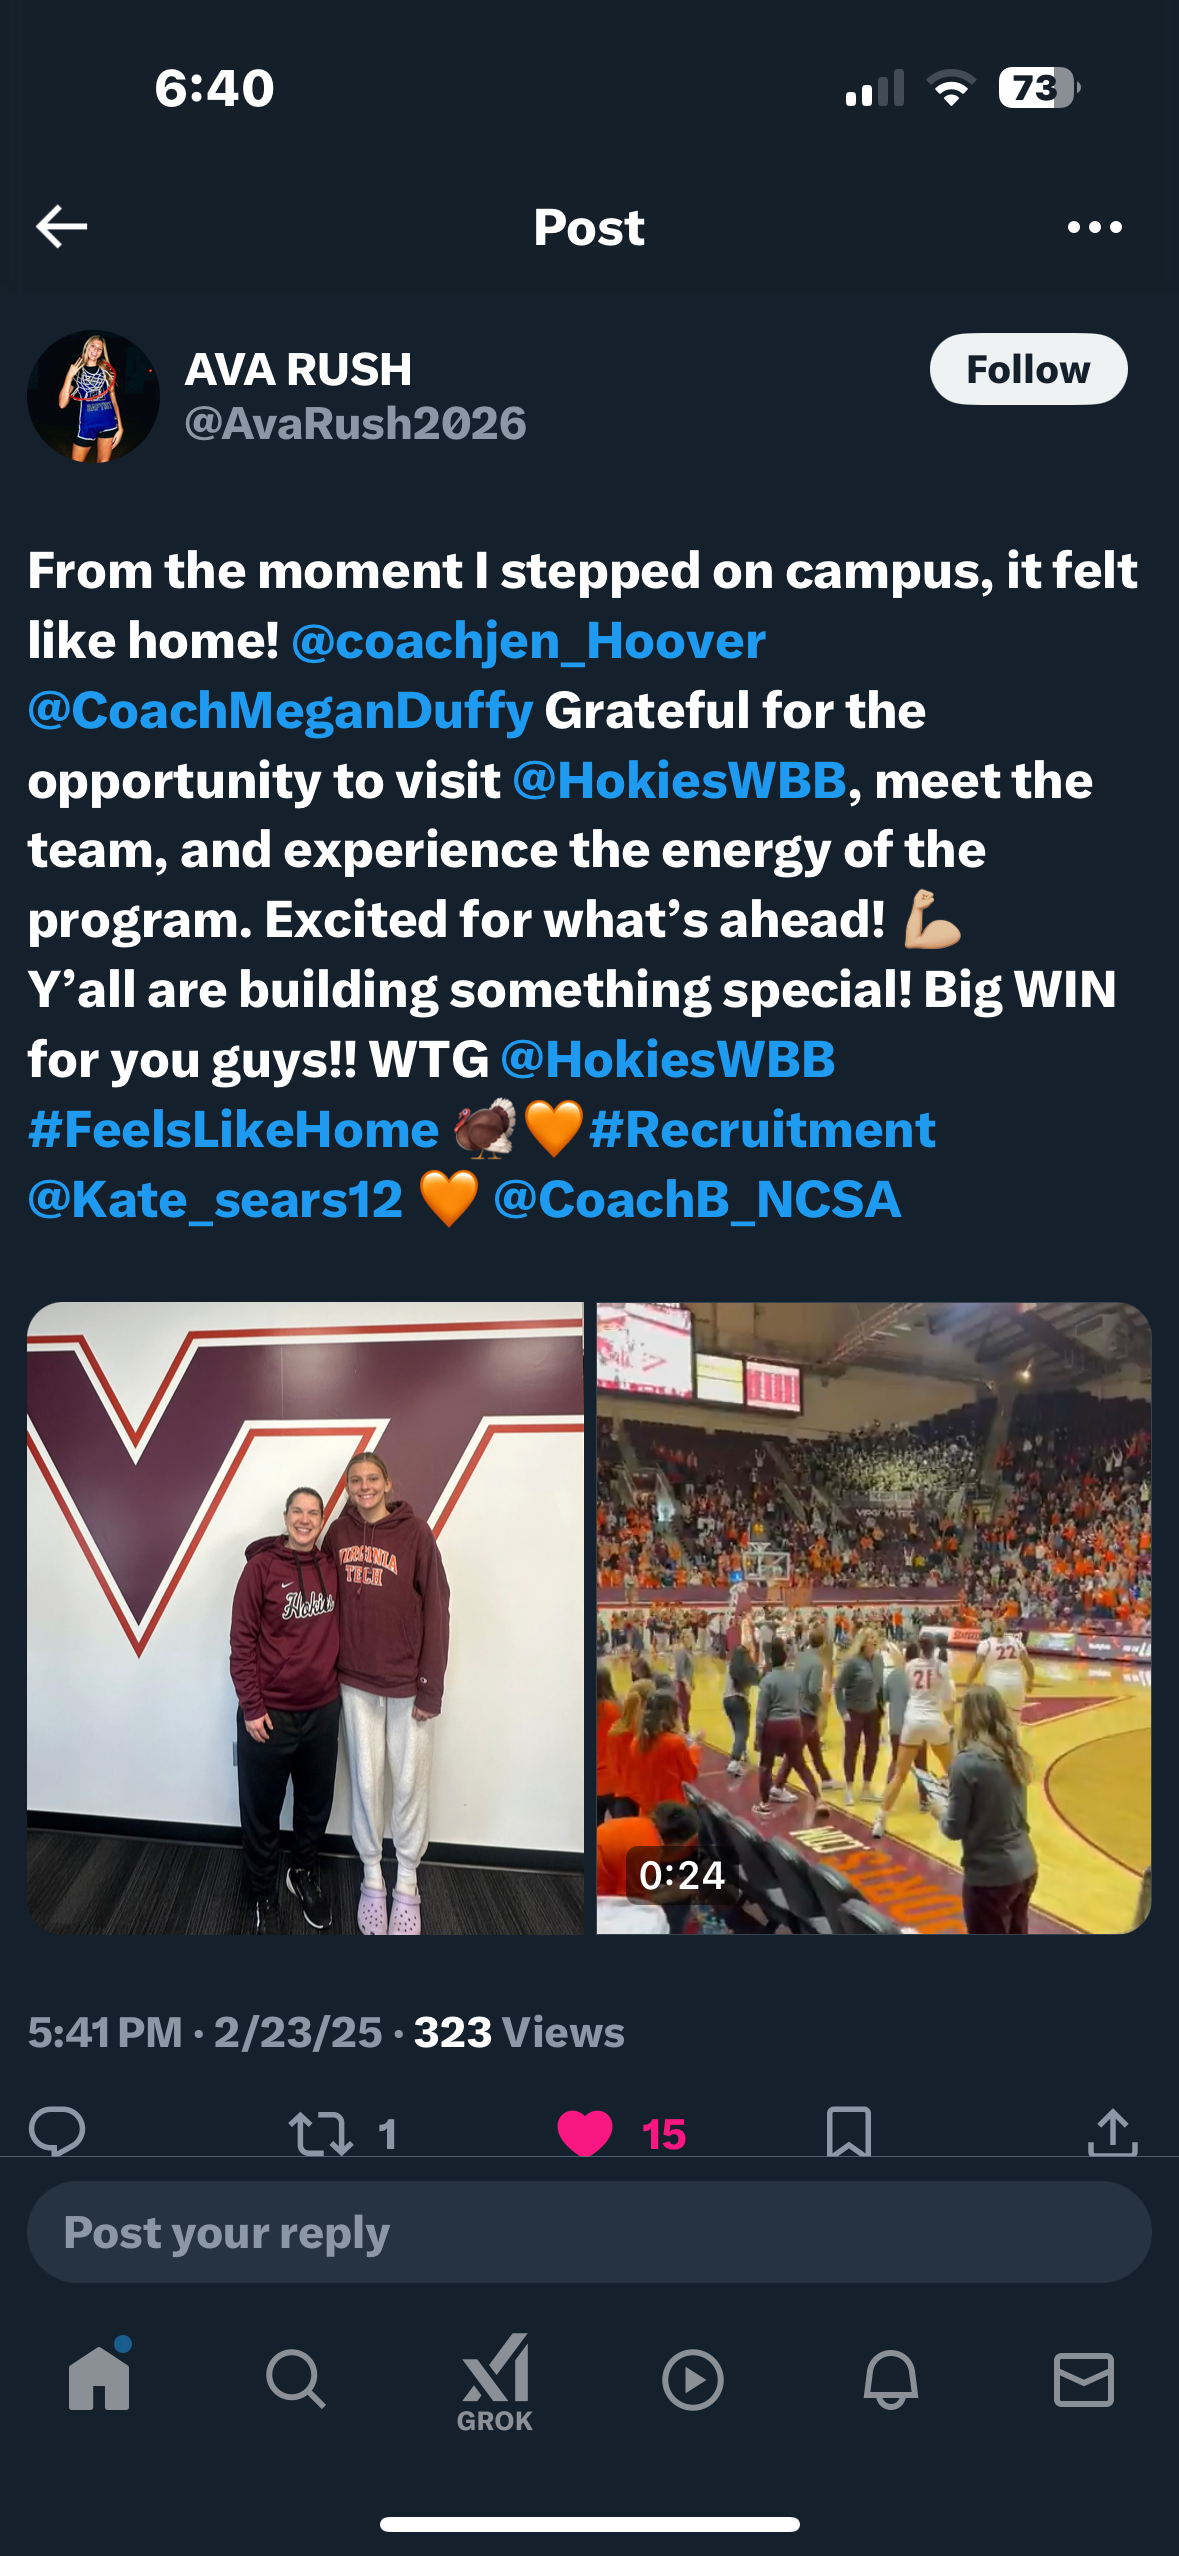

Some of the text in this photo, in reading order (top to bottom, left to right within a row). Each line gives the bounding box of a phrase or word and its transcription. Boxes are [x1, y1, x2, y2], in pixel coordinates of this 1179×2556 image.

[156, 69, 274, 107] 6:40
[1013, 74, 1058, 101] 73
[536, 209, 644, 246] Post
[184, 352, 410, 386] AVA RUSH
[968, 354, 1091, 384] Follow
[186, 406, 526, 440] @AvaRush2026
[30, 549, 1137, 598] From the moment I stepped on campus, it felt
[30, 619, 766, 669] like home! @coachjen_Hoover
[29, 689, 926, 739] @CoachMeganDuffy Grateful for the
[28, 759, 1093, 809] opportunity to visit @HokiesWBB, meet the
[27, 828, 986, 878] team, and experience the energy of the
[30, 898, 884, 948] program. Excited for what’s ahead!
[27, 968, 1115, 1018] Y’all are building something special! Big WIN
[27, 1038, 834, 1088] for you guys!! WTG @HokiesWBB
[28, 1108, 935, 1148] #FeelsLikeHome #Recruitment
[29, 1179, 902, 1226] @Kate_sears12 @CoachB_NCSA
[338, 1545, 398, 1576] VIRGINIA
[345, 1565, 383, 1587] TECH
[996, 1645, 1017, 1660] 22
[913, 1669, 931, 1690] 21
[640, 1860, 726, 1890] 0:24
[29, 2015, 624, 2052] 5:41 PM 2/23/25 323 Views
[378, 2118, 395, 2150] 1
[642, 2118, 687, 2150] 15
[66, 2214, 390, 2258] Post your reply
[456, 2410, 534, 2432] GROK
